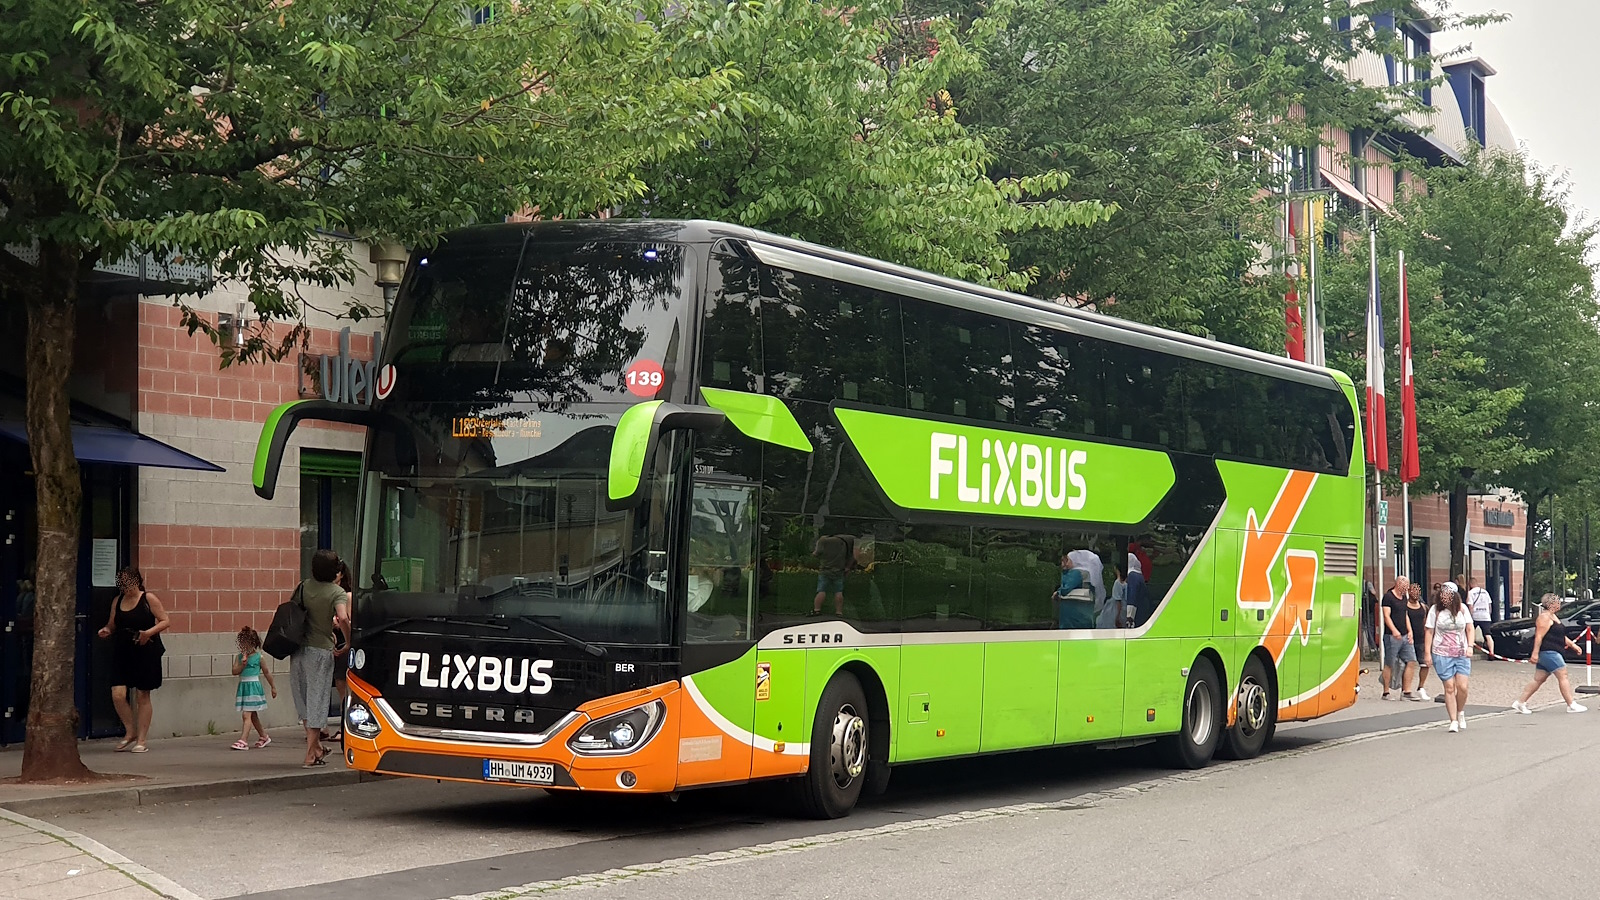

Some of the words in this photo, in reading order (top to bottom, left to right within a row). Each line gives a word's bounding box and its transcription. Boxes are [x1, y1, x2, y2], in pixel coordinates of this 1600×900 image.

[627, 370, 662, 387] 139
[783, 633, 843, 645] SETRA
[615, 663, 635, 673] BER
[409, 702, 535, 724] SETRA
[490, 762, 505, 777] HH
[511, 763, 525, 778] UM
[527, 765, 553, 780] 4939
